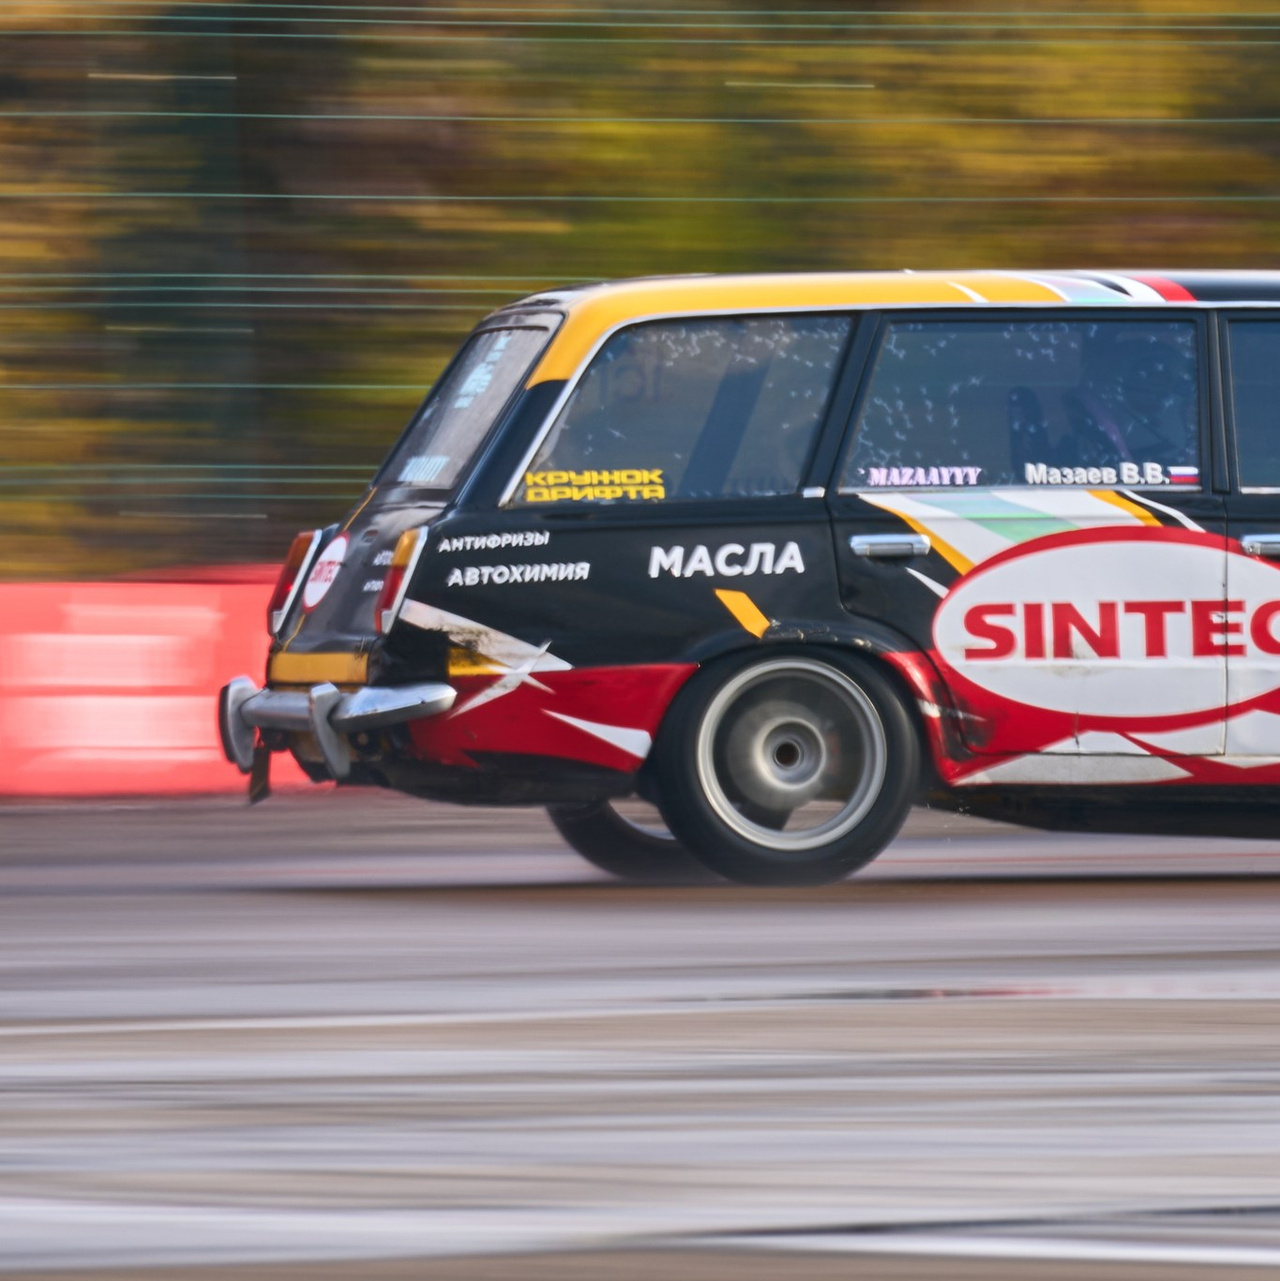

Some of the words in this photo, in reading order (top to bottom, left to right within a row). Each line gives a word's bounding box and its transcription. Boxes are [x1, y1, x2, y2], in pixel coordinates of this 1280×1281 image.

[525, 469, 664, 486] КРУЖОК
[1024, 463, 1118, 485] Мазаев
[1119, 462, 1171, 486] В.В.
[525, 485, 666, 502] ДРИФТА
[438, 530, 550, 553] АНТИФРИЗЫ
[648, 541, 805, 578] МАСЛА
[447, 561, 591, 587] АВТОХИМИЯ
